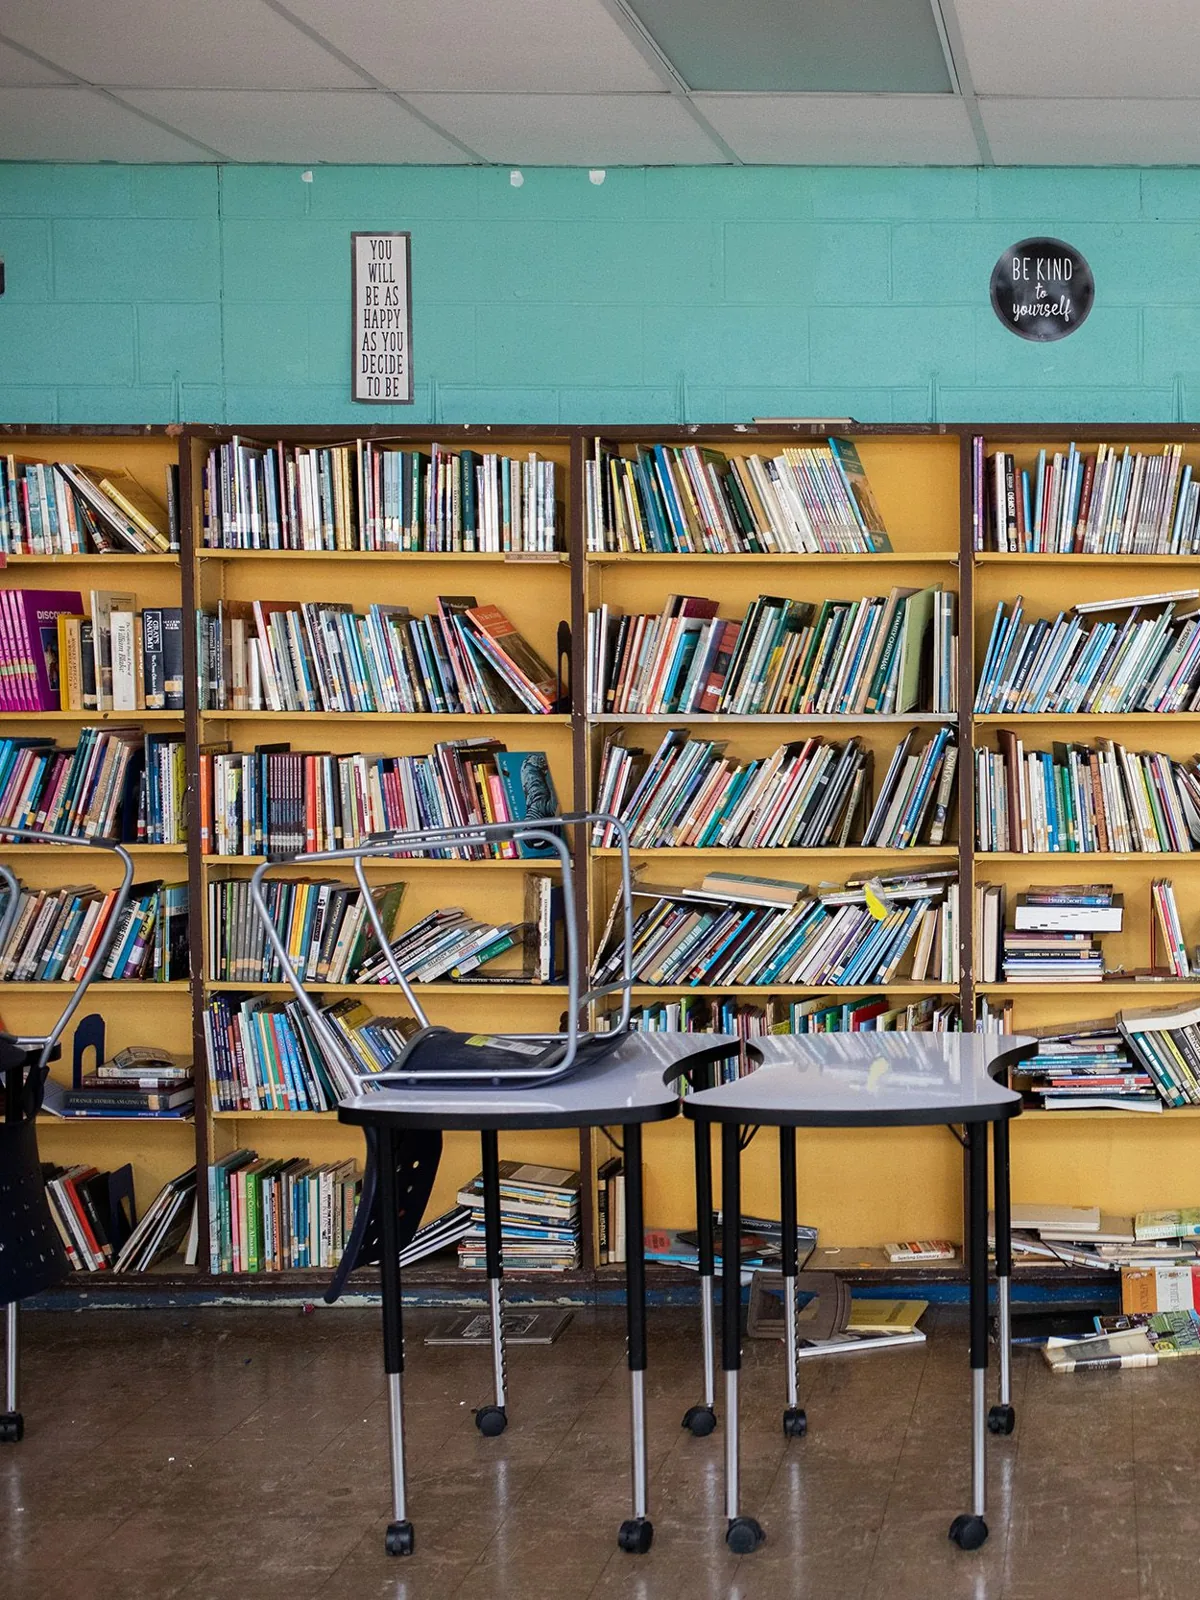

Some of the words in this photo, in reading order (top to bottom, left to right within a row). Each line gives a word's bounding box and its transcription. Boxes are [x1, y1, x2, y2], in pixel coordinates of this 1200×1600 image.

[370, 240, 392, 260] YOU
[368, 263, 396, 283] WILL
[1012, 257, 1030, 280] BE
[1036, 257, 1073, 280] KIND
[366, 286, 380, 306] BE
[384, 286, 399, 306] AS
[1035, 282, 1048, 300] to
[1012, 294, 1072, 322] yourself
[364, 308, 401, 329] HAPPY
[362, 332, 376, 352] AS
[382, 332, 404, 352] YOU
[362, 354, 404, 374] DECIDE
[366, 377, 381, 396] TO
[386, 377, 400, 397] BE
[892, 616, 901, 632] FAMILY
[880, 631, 896, 671] CHRISTMAS
[117, 911, 133, 932] WELFARE
